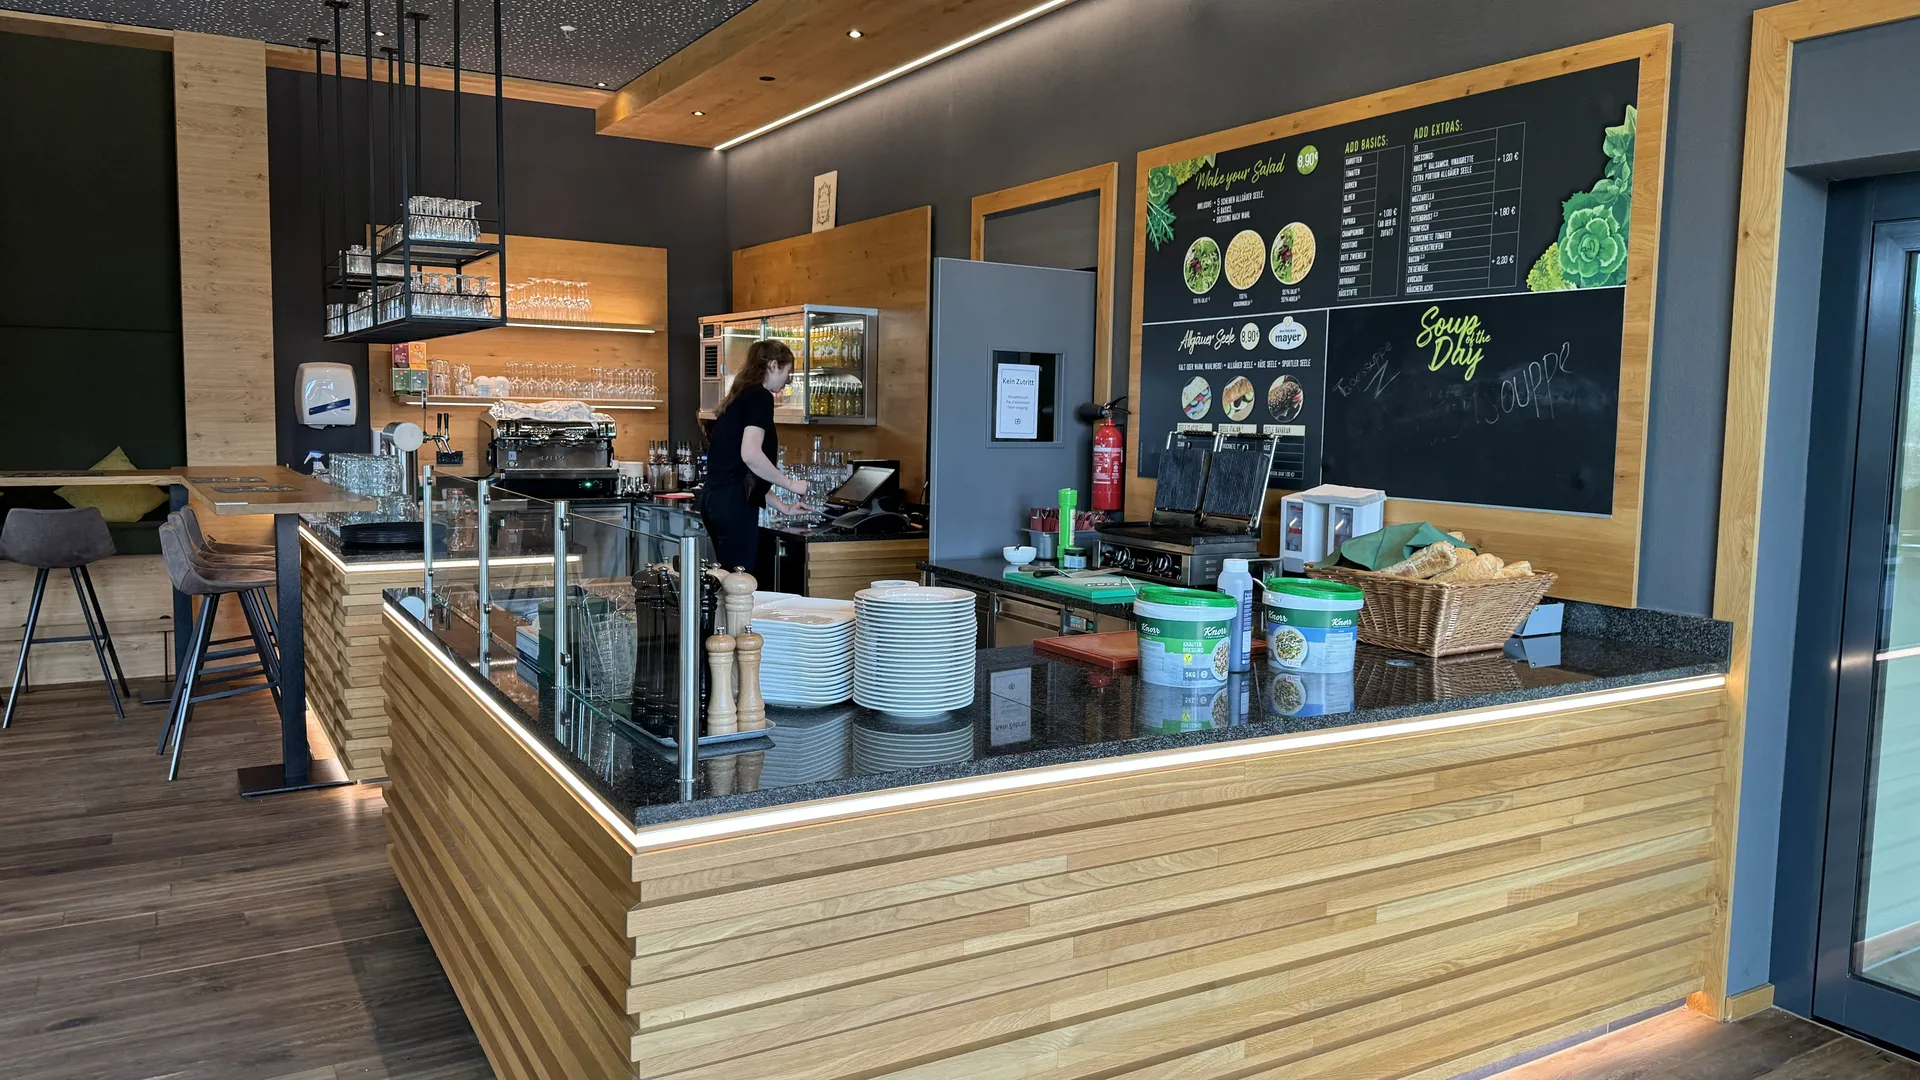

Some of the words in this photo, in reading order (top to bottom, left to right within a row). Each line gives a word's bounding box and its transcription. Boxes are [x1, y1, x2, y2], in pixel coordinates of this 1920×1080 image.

[1414, 126, 1428, 140] ADD
[1432, 120, 1463, 136] EXTRAS:
[1345, 142, 1359, 154] ADD
[1362, 134, 1388, 151] BASICS:
[1196, 168, 1224, 190] Make
[1226, 168, 1251, 191] your
[1252, 153, 1286, 183] Salad
[1416, 306, 1481, 351] Soup
[1178, 330, 1214, 355] Allgäuer
[1214, 327, 1236, 351] Seele
[1275, 333, 1301, 345] mayer
[1466, 332, 1475, 347] of
[1476, 330, 1492, 344] the
[1428, 336, 1485, 381] Day
[1016, 378, 1034, 386] Zutritt
[1268, 611, 1288, 622] Knorr
[1332, 618, 1352, 627] Knorr
[1141, 623, 1161, 635] Knorr
[1204, 627, 1226, 637] Knorr
